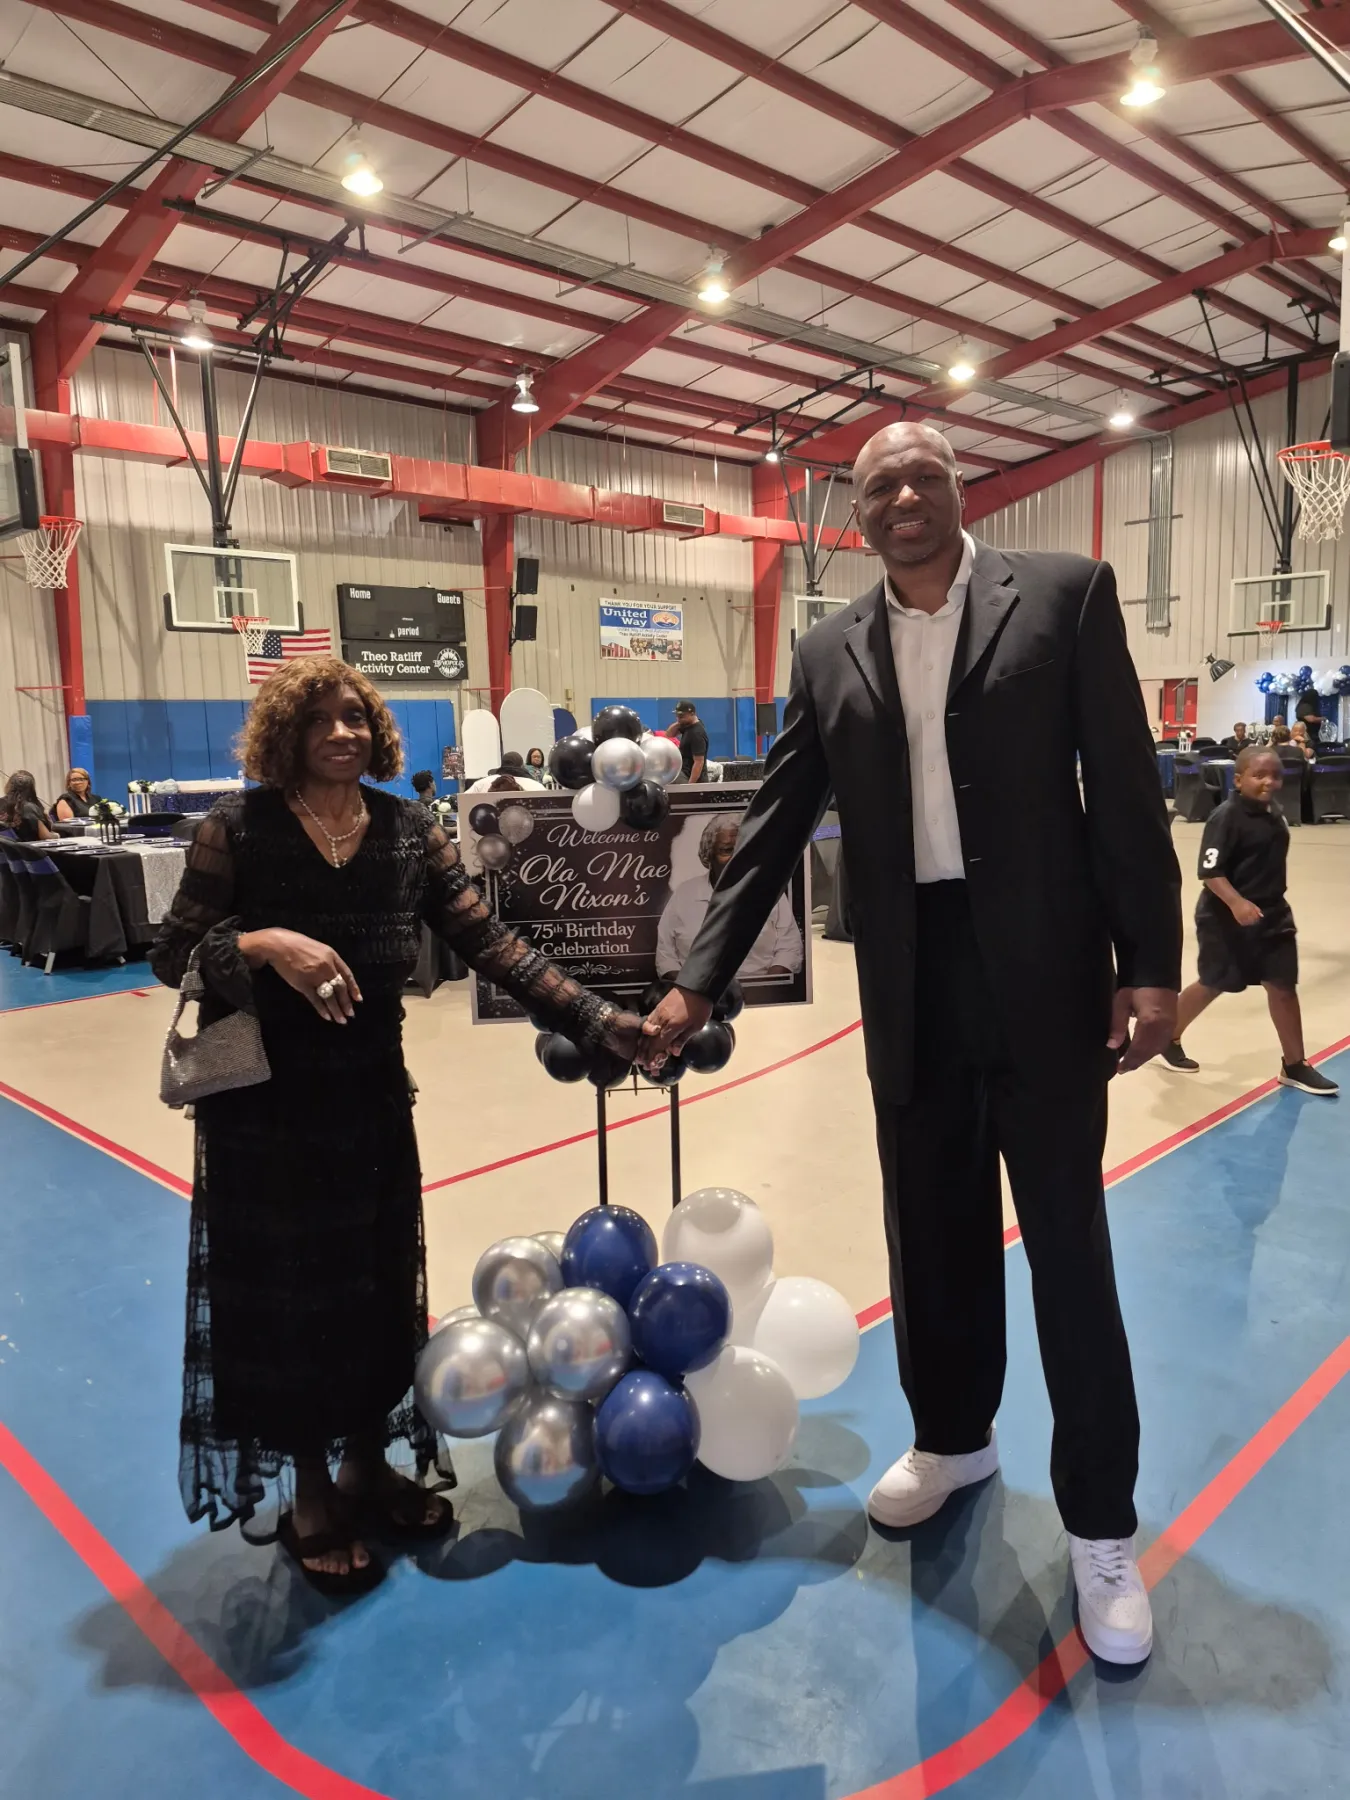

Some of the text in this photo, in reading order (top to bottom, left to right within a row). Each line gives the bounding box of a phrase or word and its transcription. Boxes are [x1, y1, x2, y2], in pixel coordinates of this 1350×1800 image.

[349, 587, 371, 599] Home
[436, 592, 461, 604] Guests
[602, 607, 647, 618] United
[621, 616, 647, 628] Way
[397, 626, 419, 638] period
[361, 651, 423, 662] Theo Ratliff
[355, 663, 395, 676] Activity
[396, 663, 431, 674] Center
[546, 824, 660, 847] Welcome to
[1202, 848, 1219, 869] 3
[519, 851, 671, 885] Ola Mae
[539, 882, 650, 911] Nixon's
[531, 921, 636, 940] 75th Birthday
[540, 941, 630, 957] Celebration
